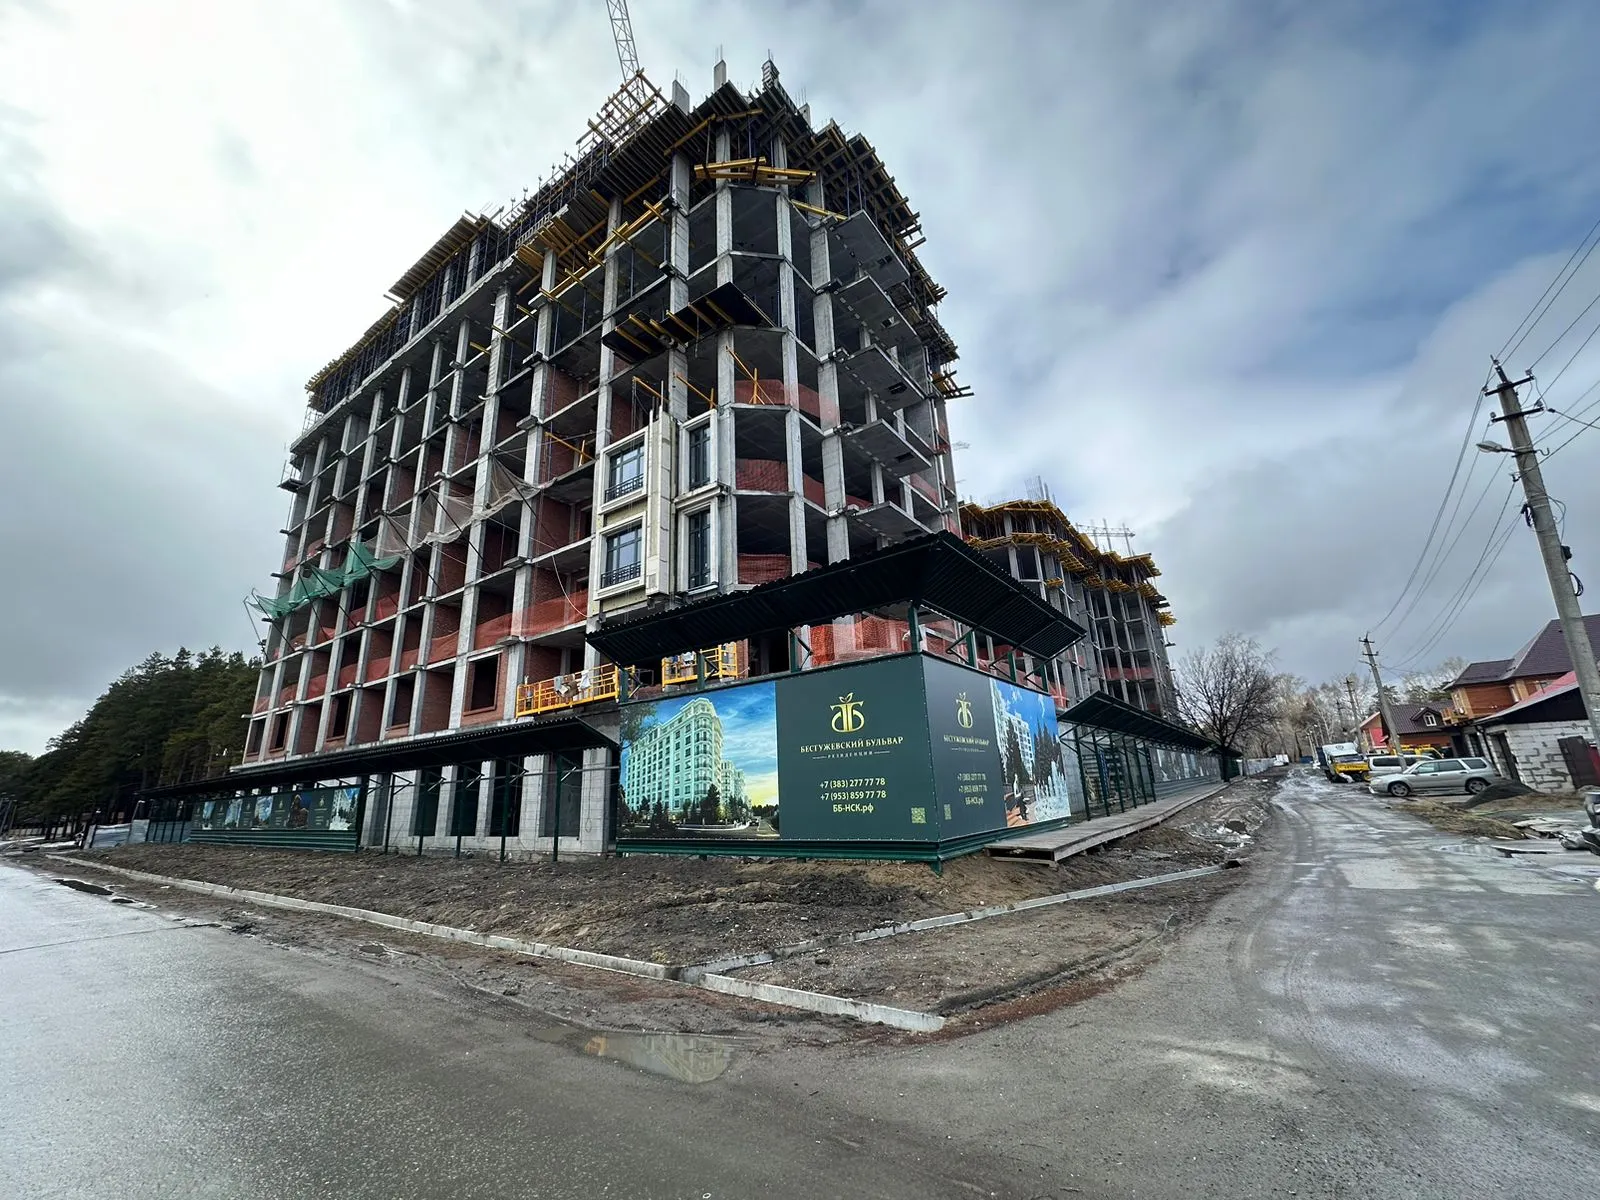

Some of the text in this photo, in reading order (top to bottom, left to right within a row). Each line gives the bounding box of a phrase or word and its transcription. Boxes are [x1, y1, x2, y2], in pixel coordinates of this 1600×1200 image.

[800, 736, 904, 753] БЕСТУЖЕВСКИЙ БУЛЬВАР
[830, 780, 848, 789] (383)
[849, 779, 863, 787] 277
[875, 778, 886, 786] 78
[831, 792, 849, 801] (953)
[865, 791, 875, 799] 77
[876, 790, 887, 798] 78
[833, 803, 874, 813] ББ-НСК.рф
